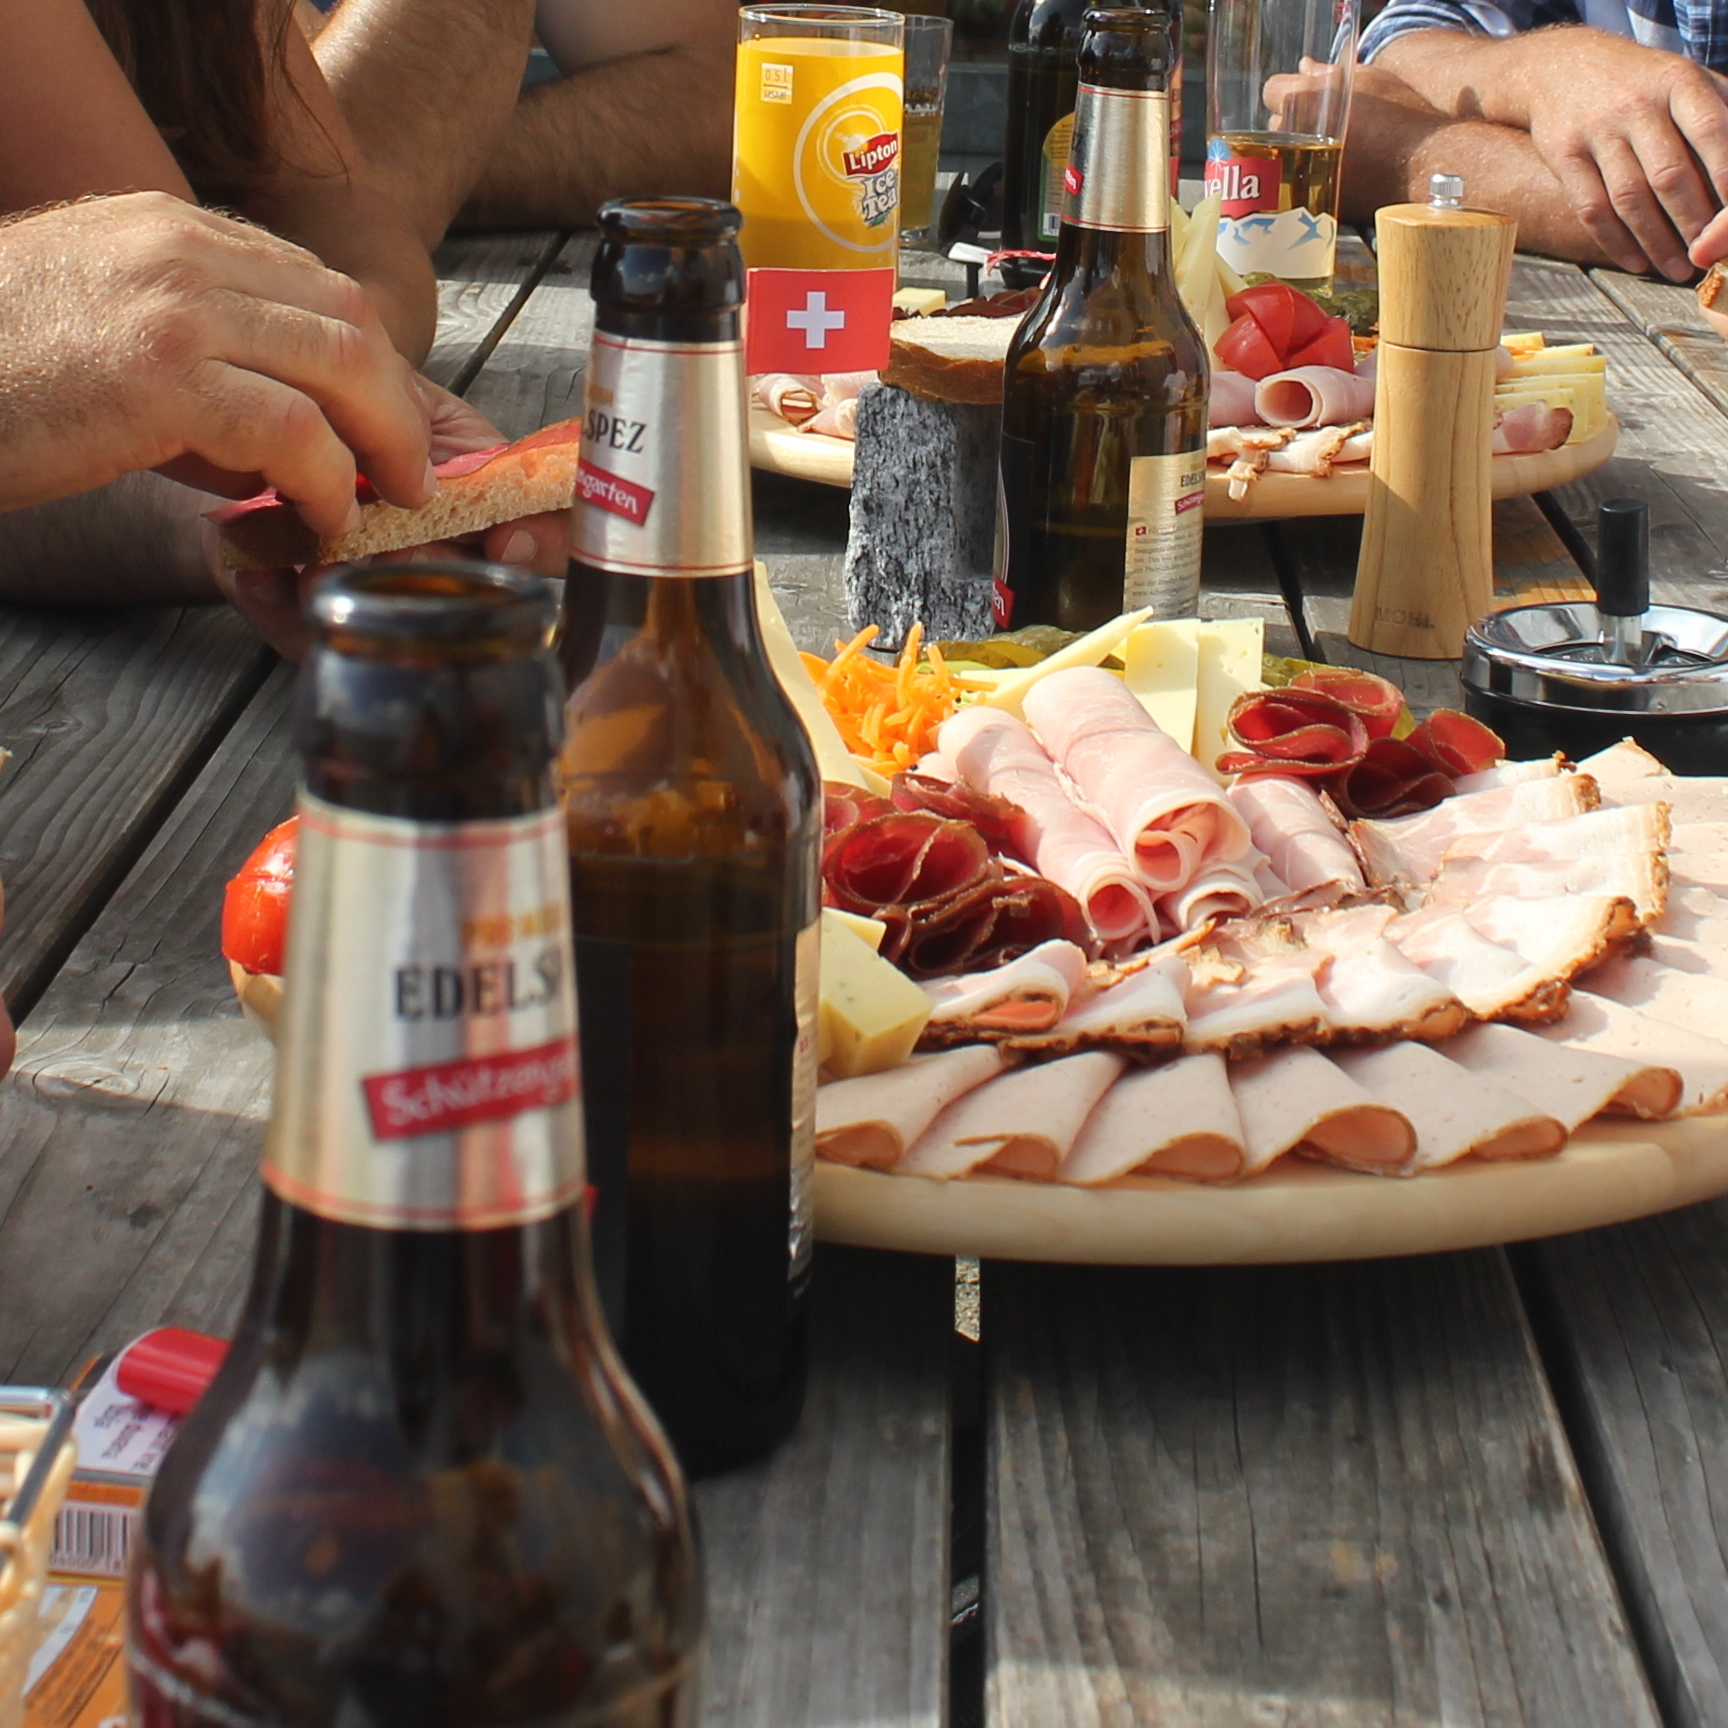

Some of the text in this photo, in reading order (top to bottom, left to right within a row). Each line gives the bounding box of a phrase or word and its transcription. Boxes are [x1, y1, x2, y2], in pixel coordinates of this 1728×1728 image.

[849, 139, 899, 171] Lipton
[862, 170, 895, 198] Ice
[863, 189, 898, 220] Tea
